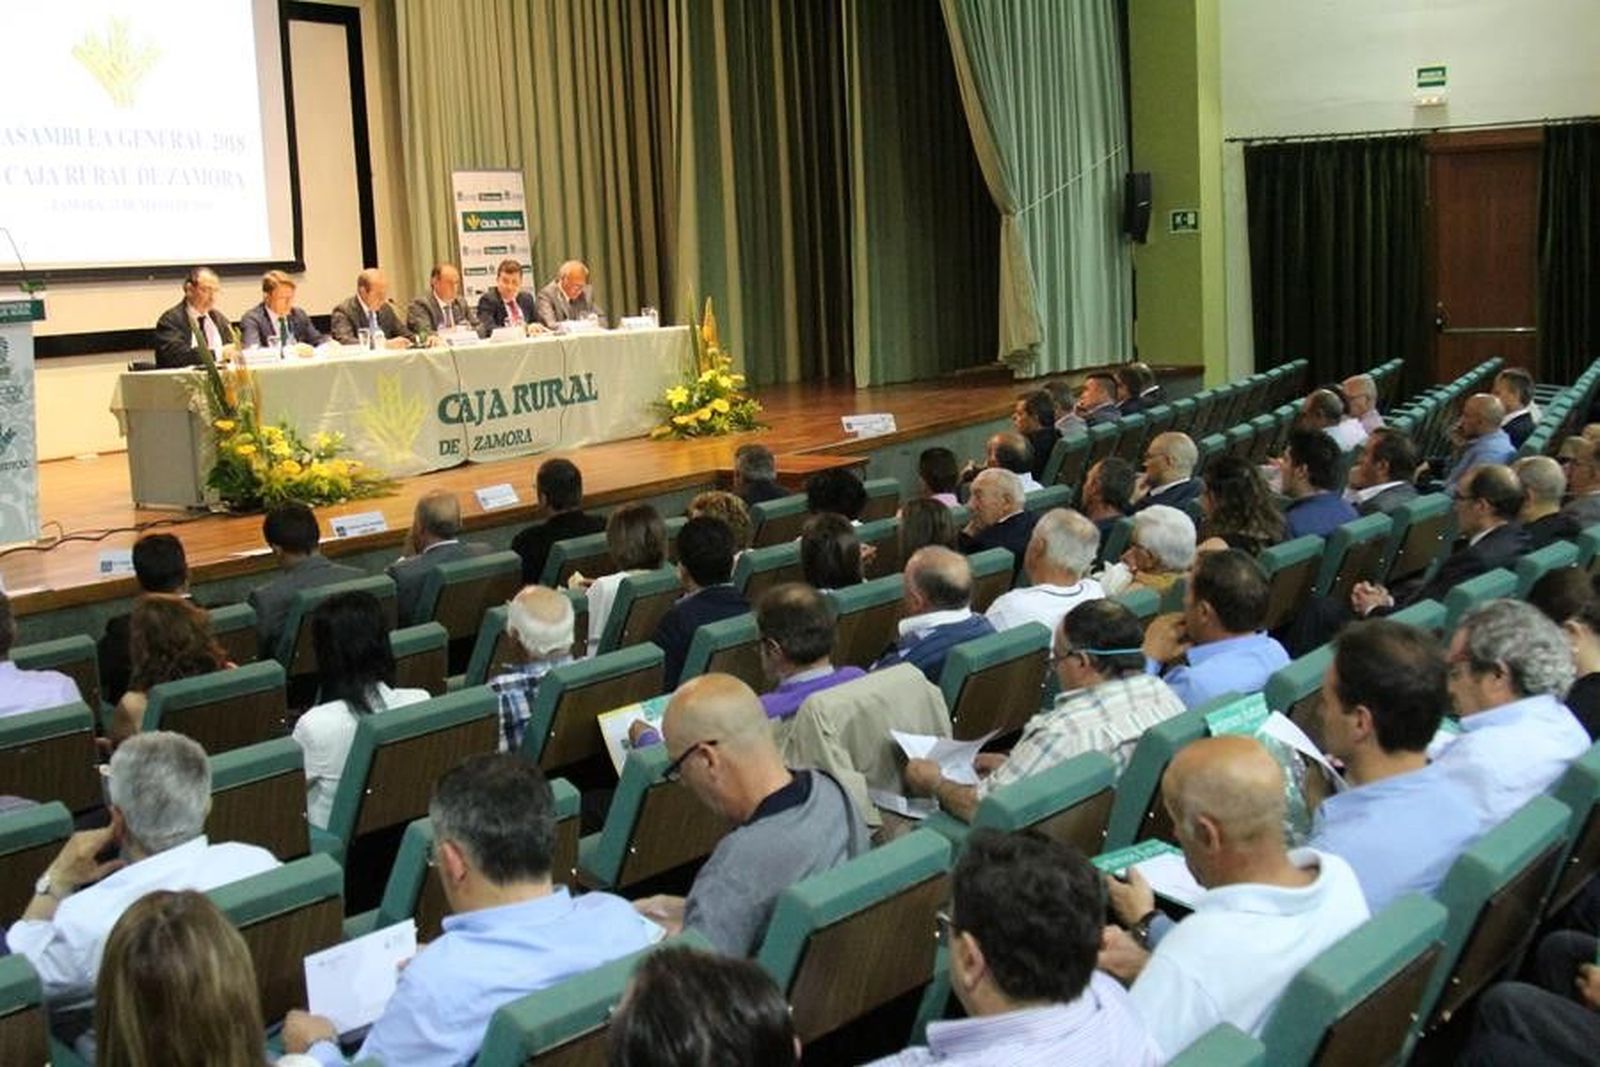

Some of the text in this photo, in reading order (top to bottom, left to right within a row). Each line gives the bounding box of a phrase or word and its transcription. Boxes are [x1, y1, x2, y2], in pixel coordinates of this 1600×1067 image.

[2, 127, 113, 148] ASAMBLEA
[118, 130, 204, 151] GENERAL
[3, 166, 247, 190] CAJA RURAL DE ZAMORA
[437, 373, 598, 426] CAJA RURAL
[438, 428, 533, 456] DE ZAMORA
